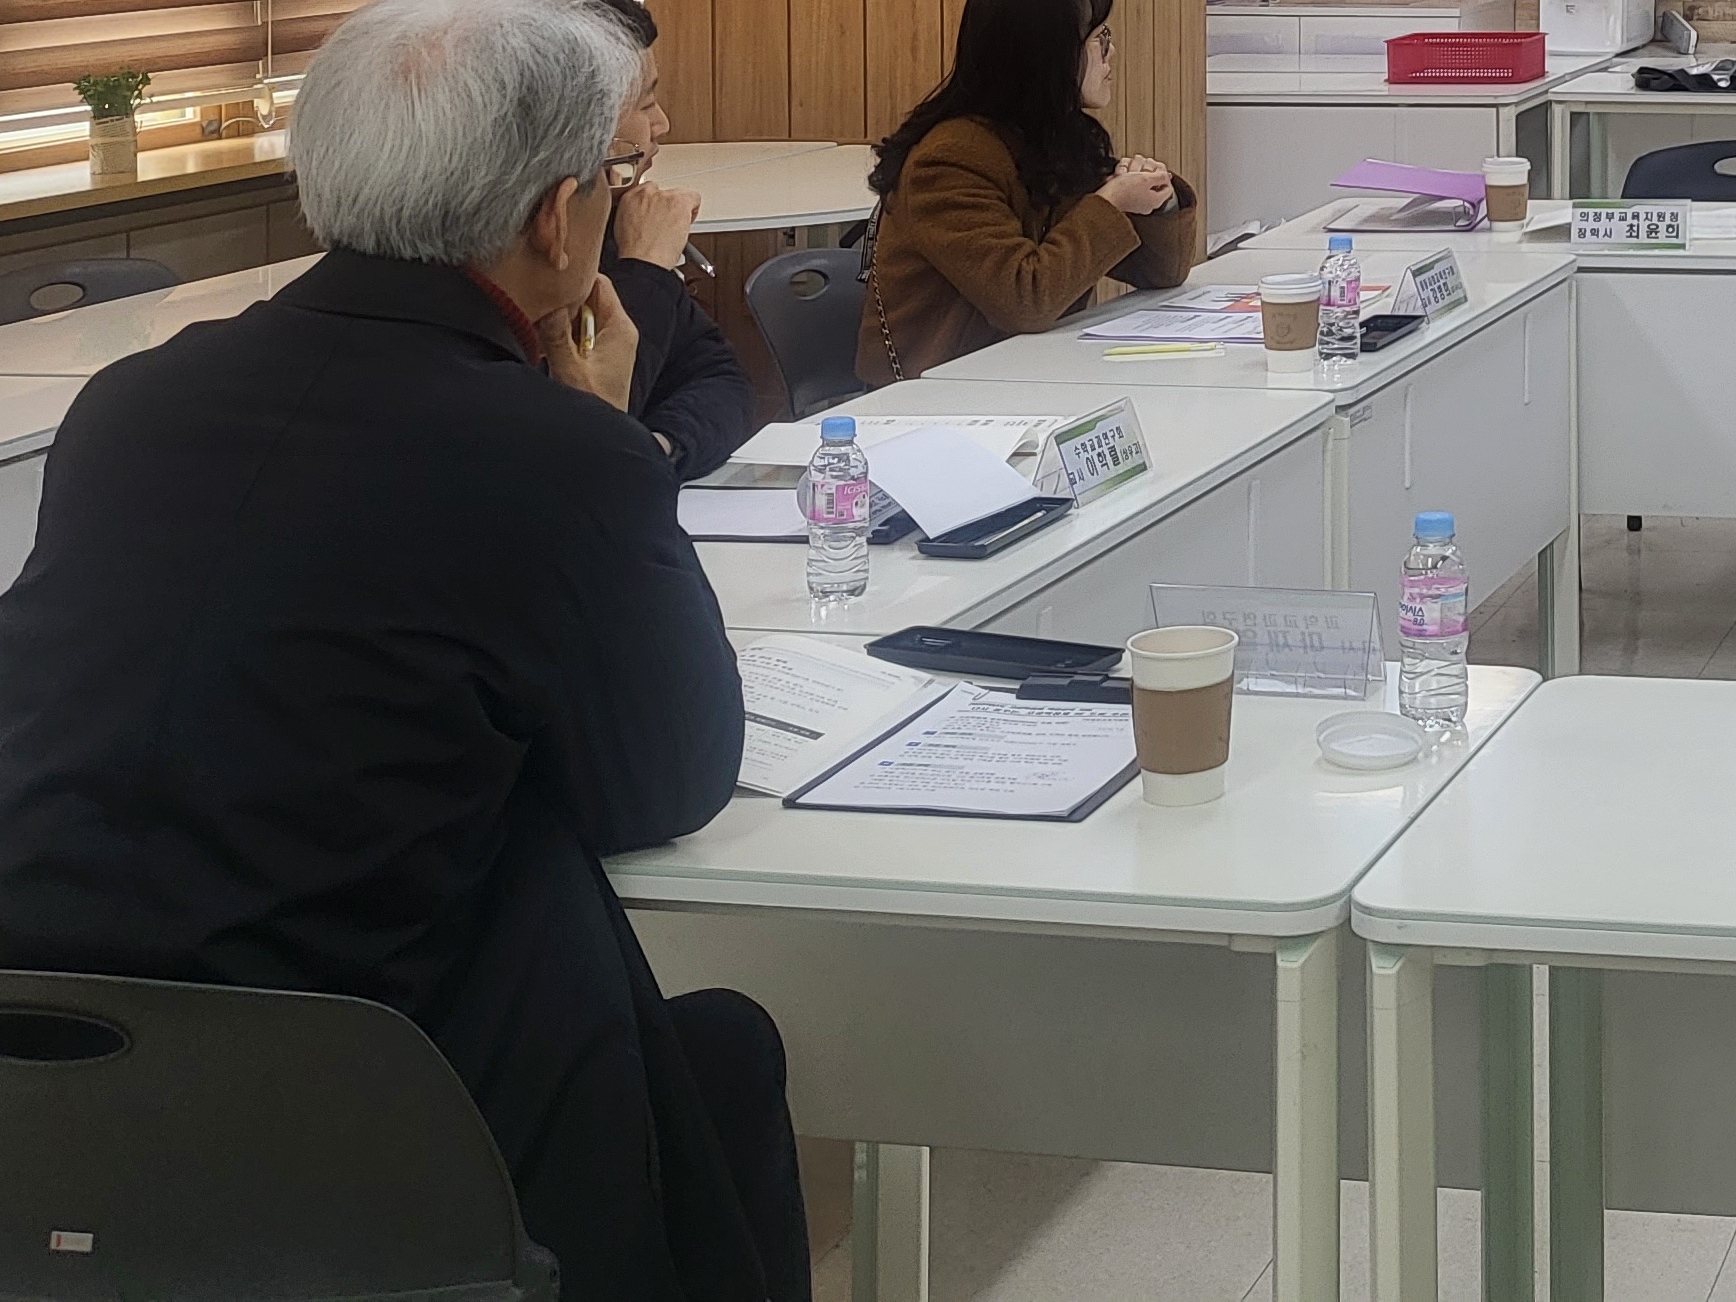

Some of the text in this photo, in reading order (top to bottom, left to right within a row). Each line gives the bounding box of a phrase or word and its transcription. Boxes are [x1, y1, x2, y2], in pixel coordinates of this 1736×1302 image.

[1579, 211, 1679, 224] 의정부교육지원청
[1625, 222, 1680, 239] 최윤희
[1074, 425, 1124, 459] 수학교과연구회
